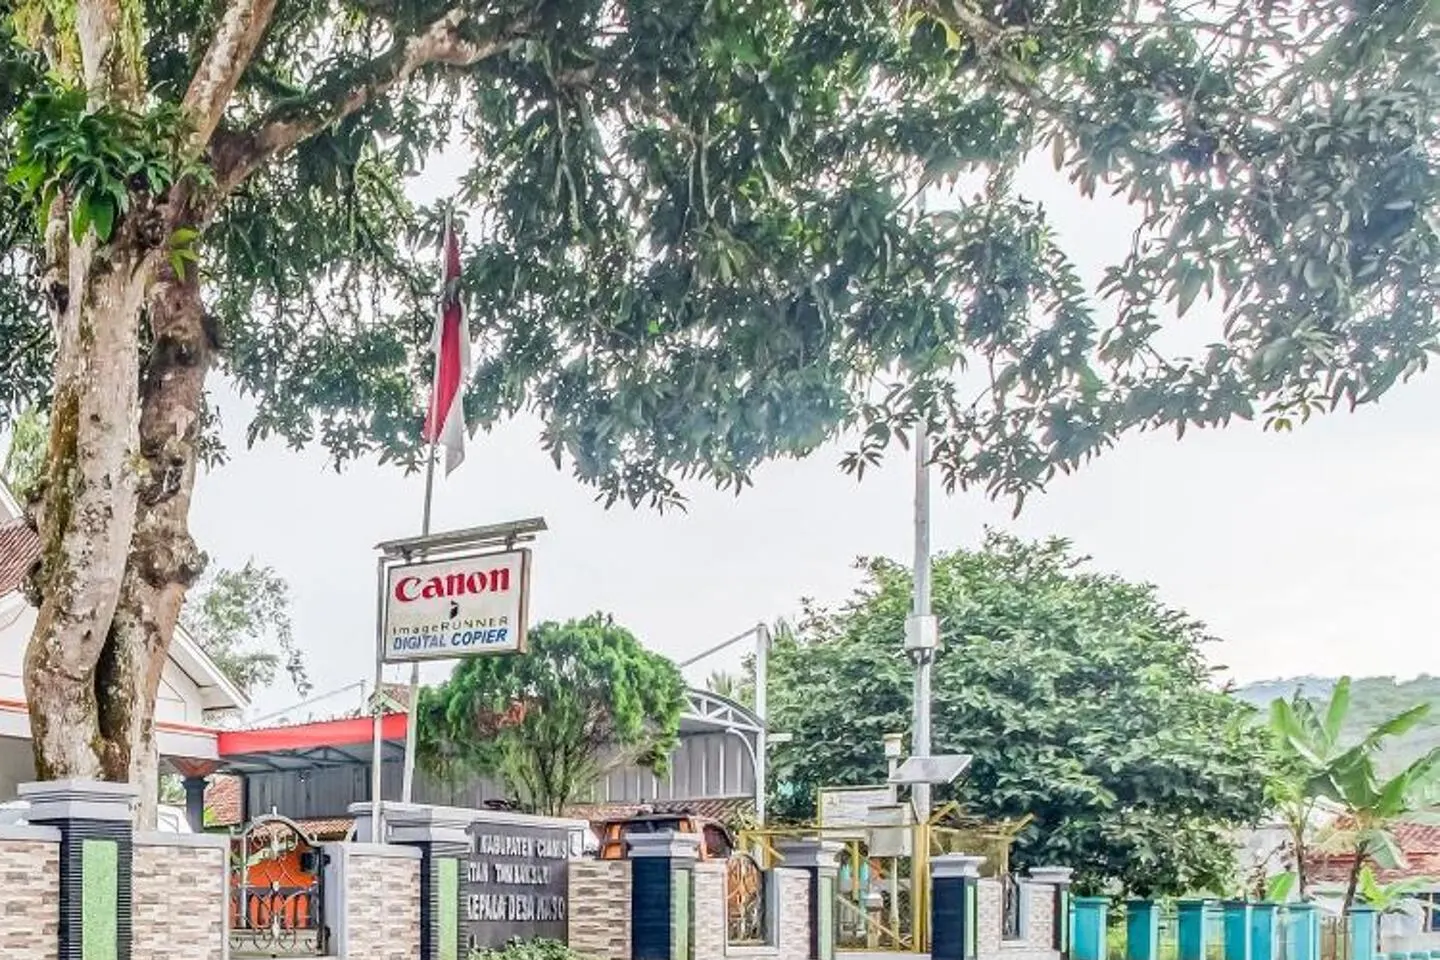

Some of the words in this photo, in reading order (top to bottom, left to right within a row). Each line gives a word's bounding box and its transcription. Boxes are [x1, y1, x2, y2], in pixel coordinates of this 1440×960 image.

[394, 567, 510, 602] Canon
[393, 633, 447, 650] DIGITAL
[451, 628, 508, 646] COPIER
